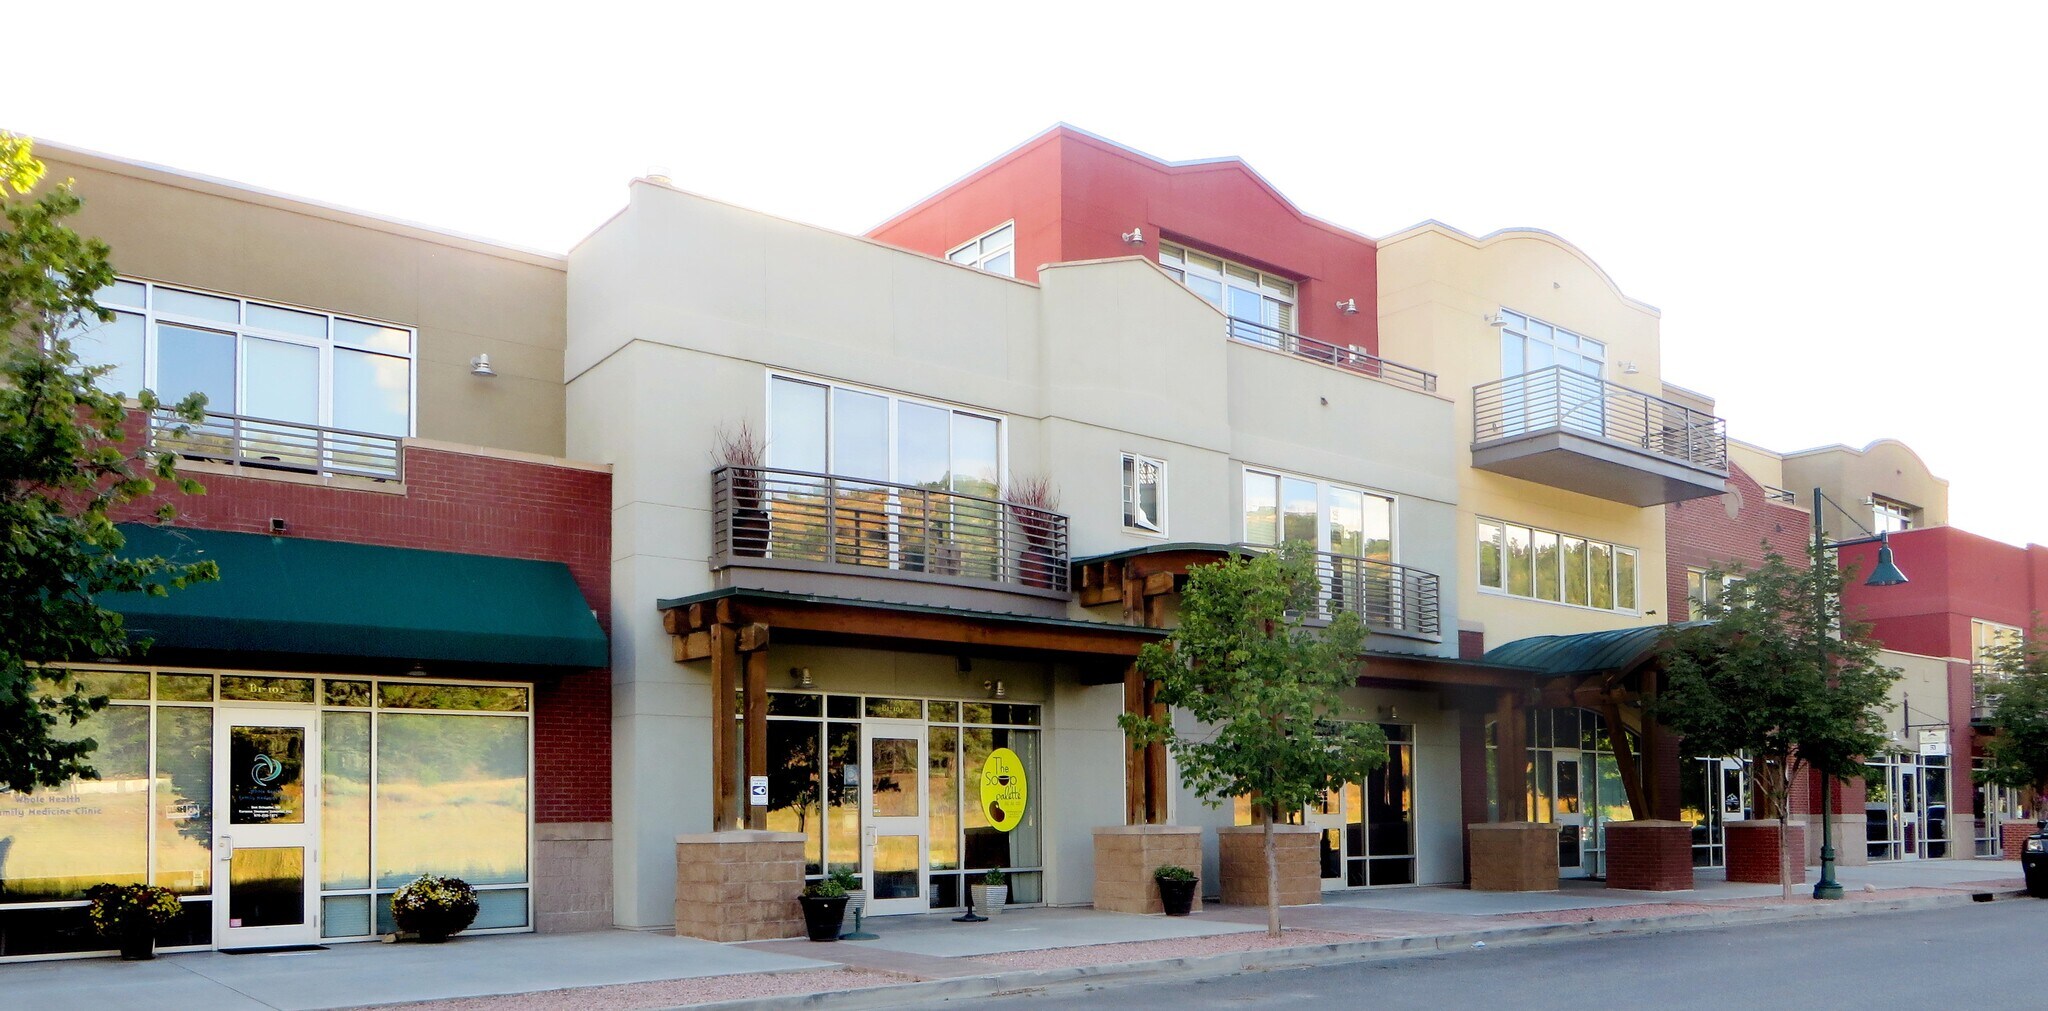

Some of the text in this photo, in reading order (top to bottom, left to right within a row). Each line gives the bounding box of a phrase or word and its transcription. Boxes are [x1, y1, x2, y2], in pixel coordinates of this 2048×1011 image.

[993, 756, 1009, 774] The
[15, 795, 81, 803] Whole Health
[75, 807, 103, 815] Clinic
